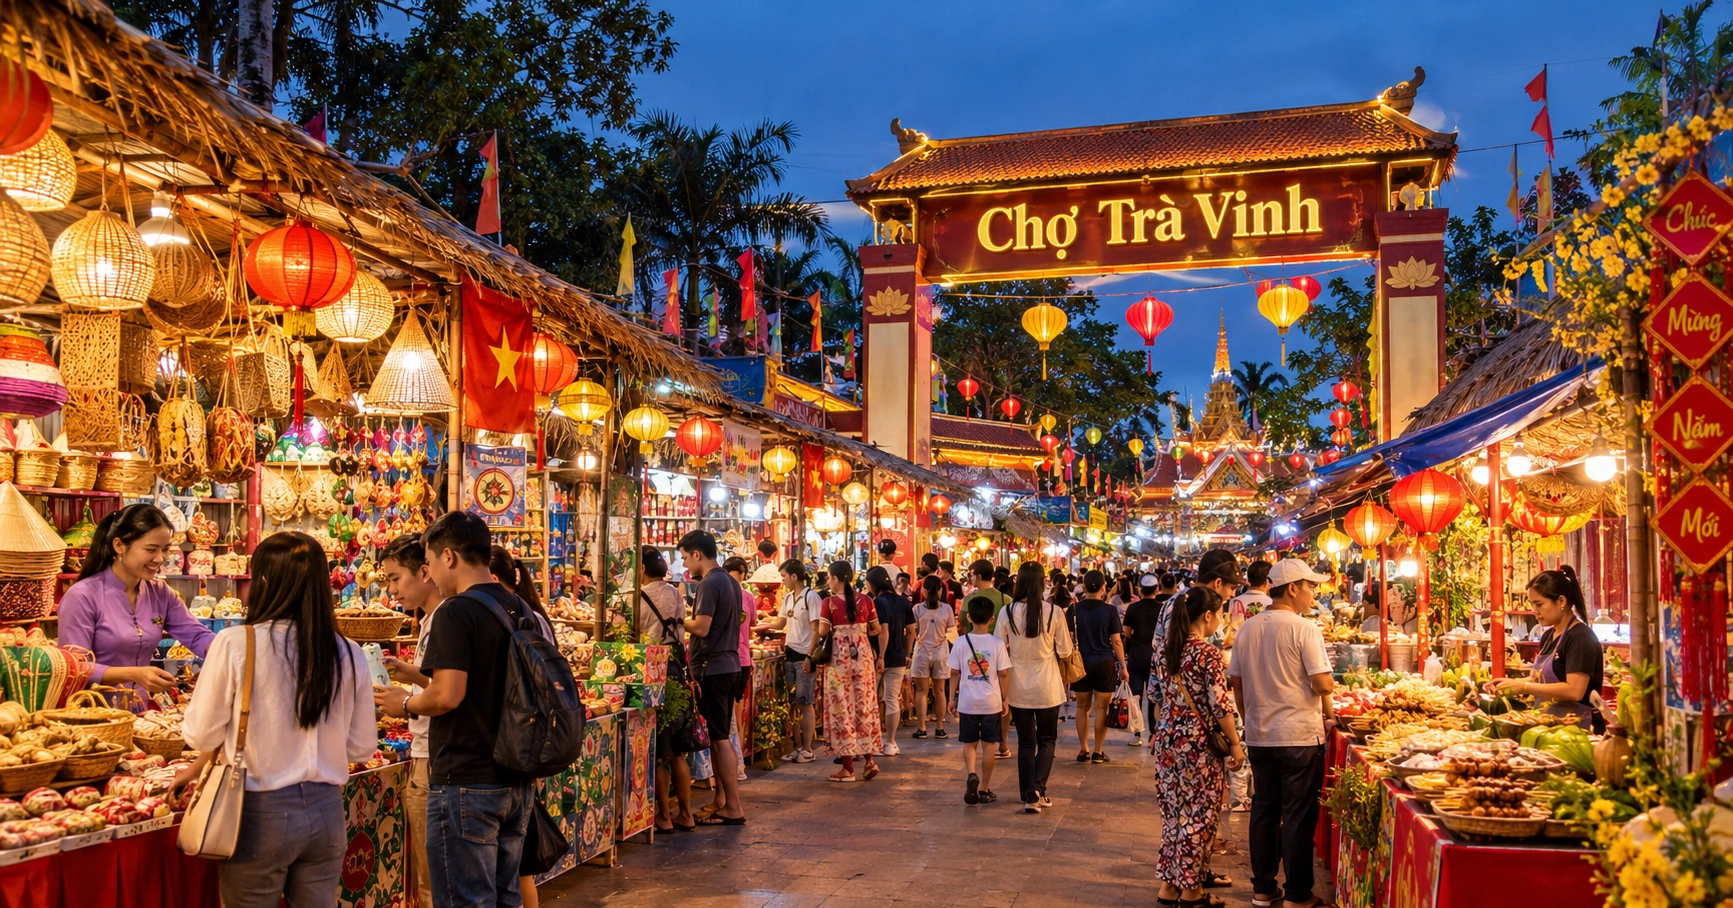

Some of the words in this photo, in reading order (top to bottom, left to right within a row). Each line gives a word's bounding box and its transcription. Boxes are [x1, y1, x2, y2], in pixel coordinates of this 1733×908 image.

[977, 202, 1079, 260] Chợ
[1098, 193, 1186, 245] Trà
[1193, 182, 1323, 240] Vinh
[1665, 200, 1718, 234] Chúc
[1667, 303, 1724, 342] Mừng
[1680, 506, 1721, 544] Mới
